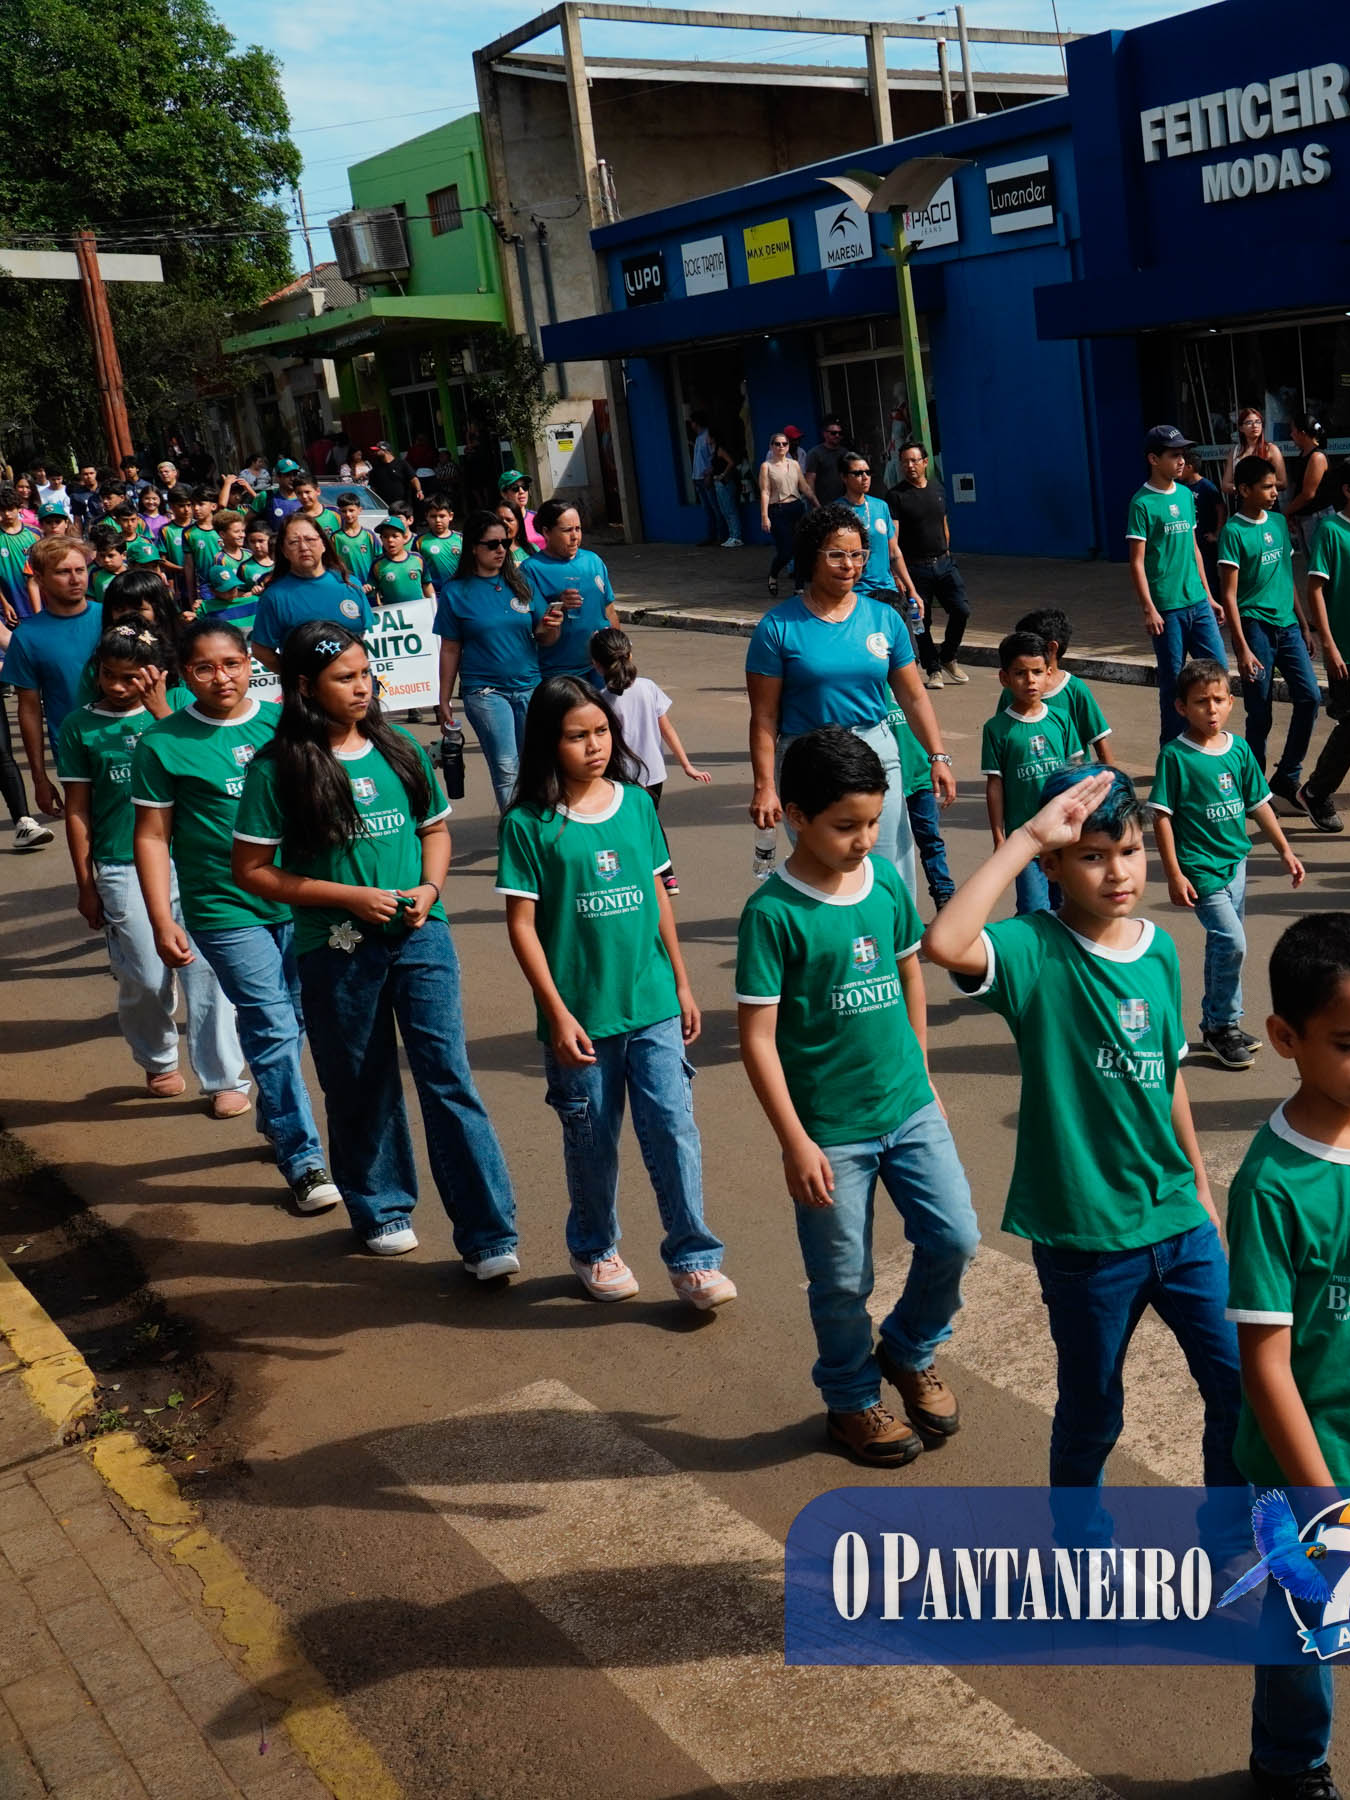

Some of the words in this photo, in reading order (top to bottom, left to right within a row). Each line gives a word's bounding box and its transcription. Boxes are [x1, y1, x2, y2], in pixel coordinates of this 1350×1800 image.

[1201, 143, 1331, 204] MODAS
[990, 181, 1047, 210] Lunender
[911, 201, 951, 229] PACO
[921, 225, 942, 236] JEANS
[747, 248, 763, 260] MAX
[765, 241, 790, 254] DENIM
[828, 244, 864, 263] MARESIA
[684, 256, 701, 277] DOCE
[700, 252, 725, 274] TRAMA
[624, 265, 661, 296] LUPO
[367, 609, 413, 634] PAL
[364, 634, 422, 659] NITO
[376, 661, 394, 673] DE
[388, 681, 431, 696] BASQUETE
[576, 890, 643, 913] BONITO
[832, 979, 900, 1010] BONITO
[1096, 1047, 1165, 1080] BONITO
